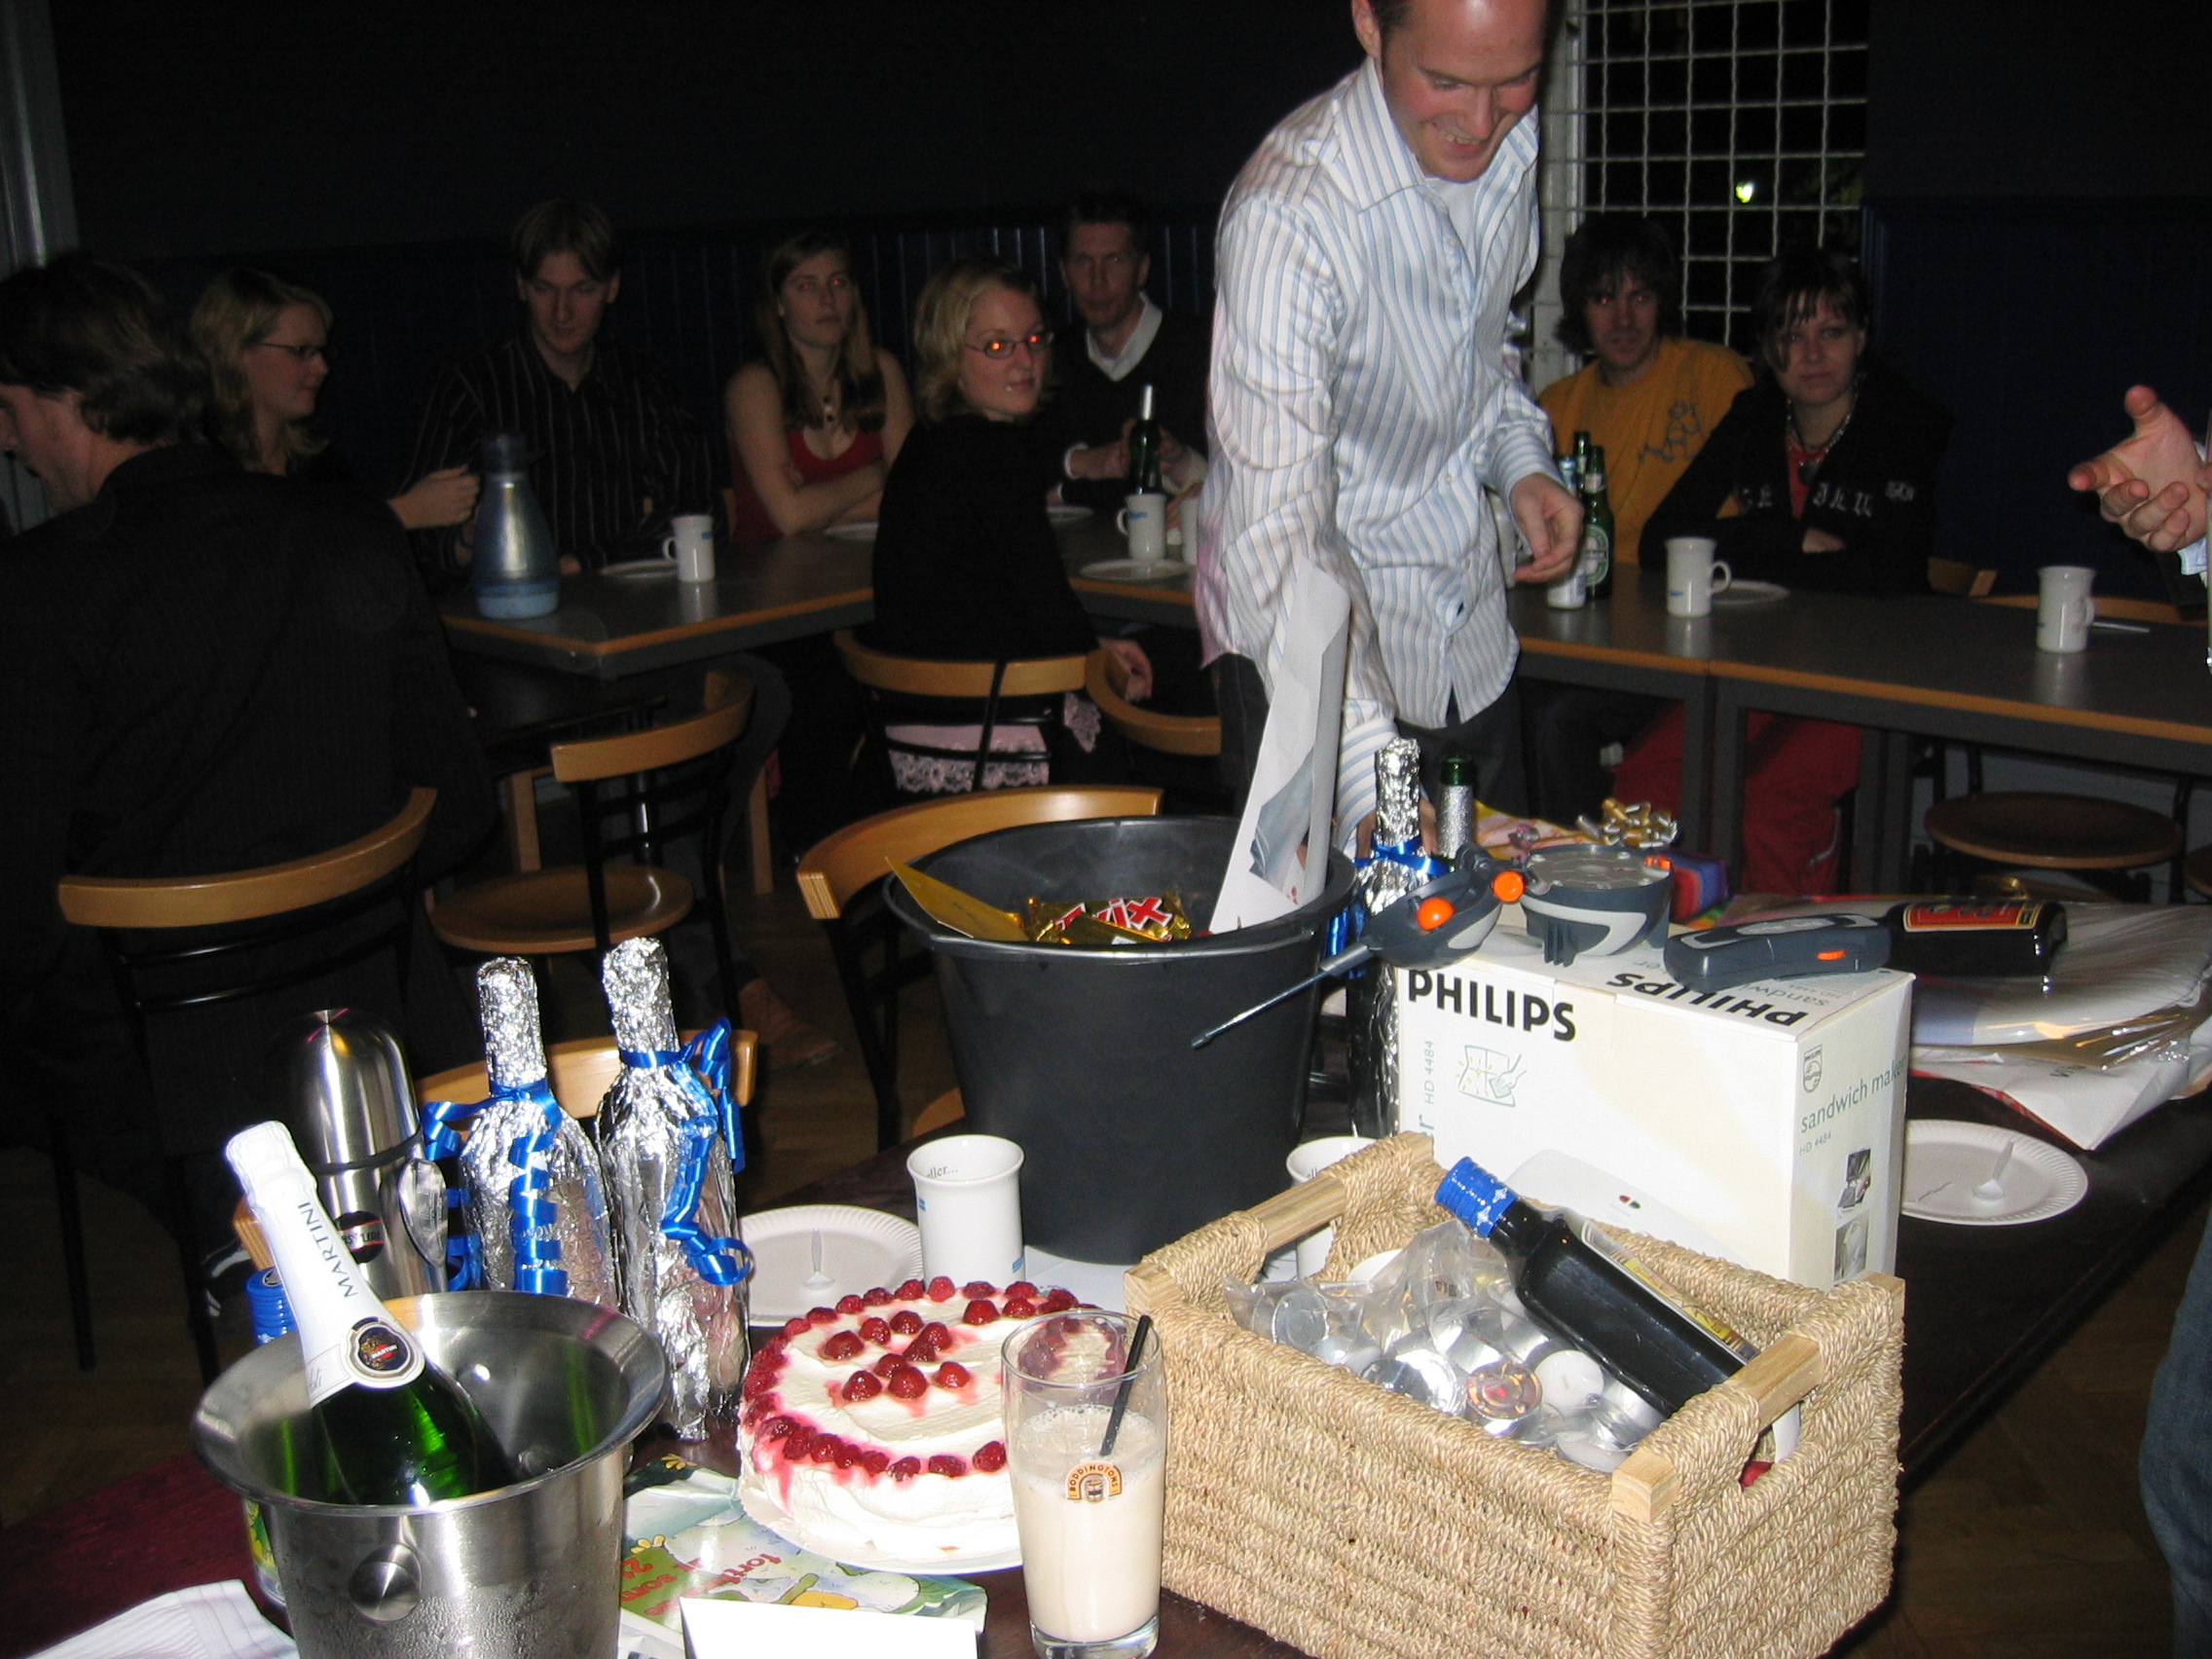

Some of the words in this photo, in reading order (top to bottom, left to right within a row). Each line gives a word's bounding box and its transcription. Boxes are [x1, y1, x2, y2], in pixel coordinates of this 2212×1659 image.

[1409, 970, 1576, 1042] PHILIPS
[1597, 973, 1808, 1026] PHILIPS
[1423, 1040, 1435, 1075] 4484
[1423, 1080, 1435, 1104] HD
[1801, 1078, 1867, 1133] sandwich
[1871, 1054, 1907, 1094] maker
[1798, 1141, 1813, 1157] HD
[297, 1201, 359, 1299] MARTINI
[1069, 1463, 1119, 1492] BODDINGTONS
